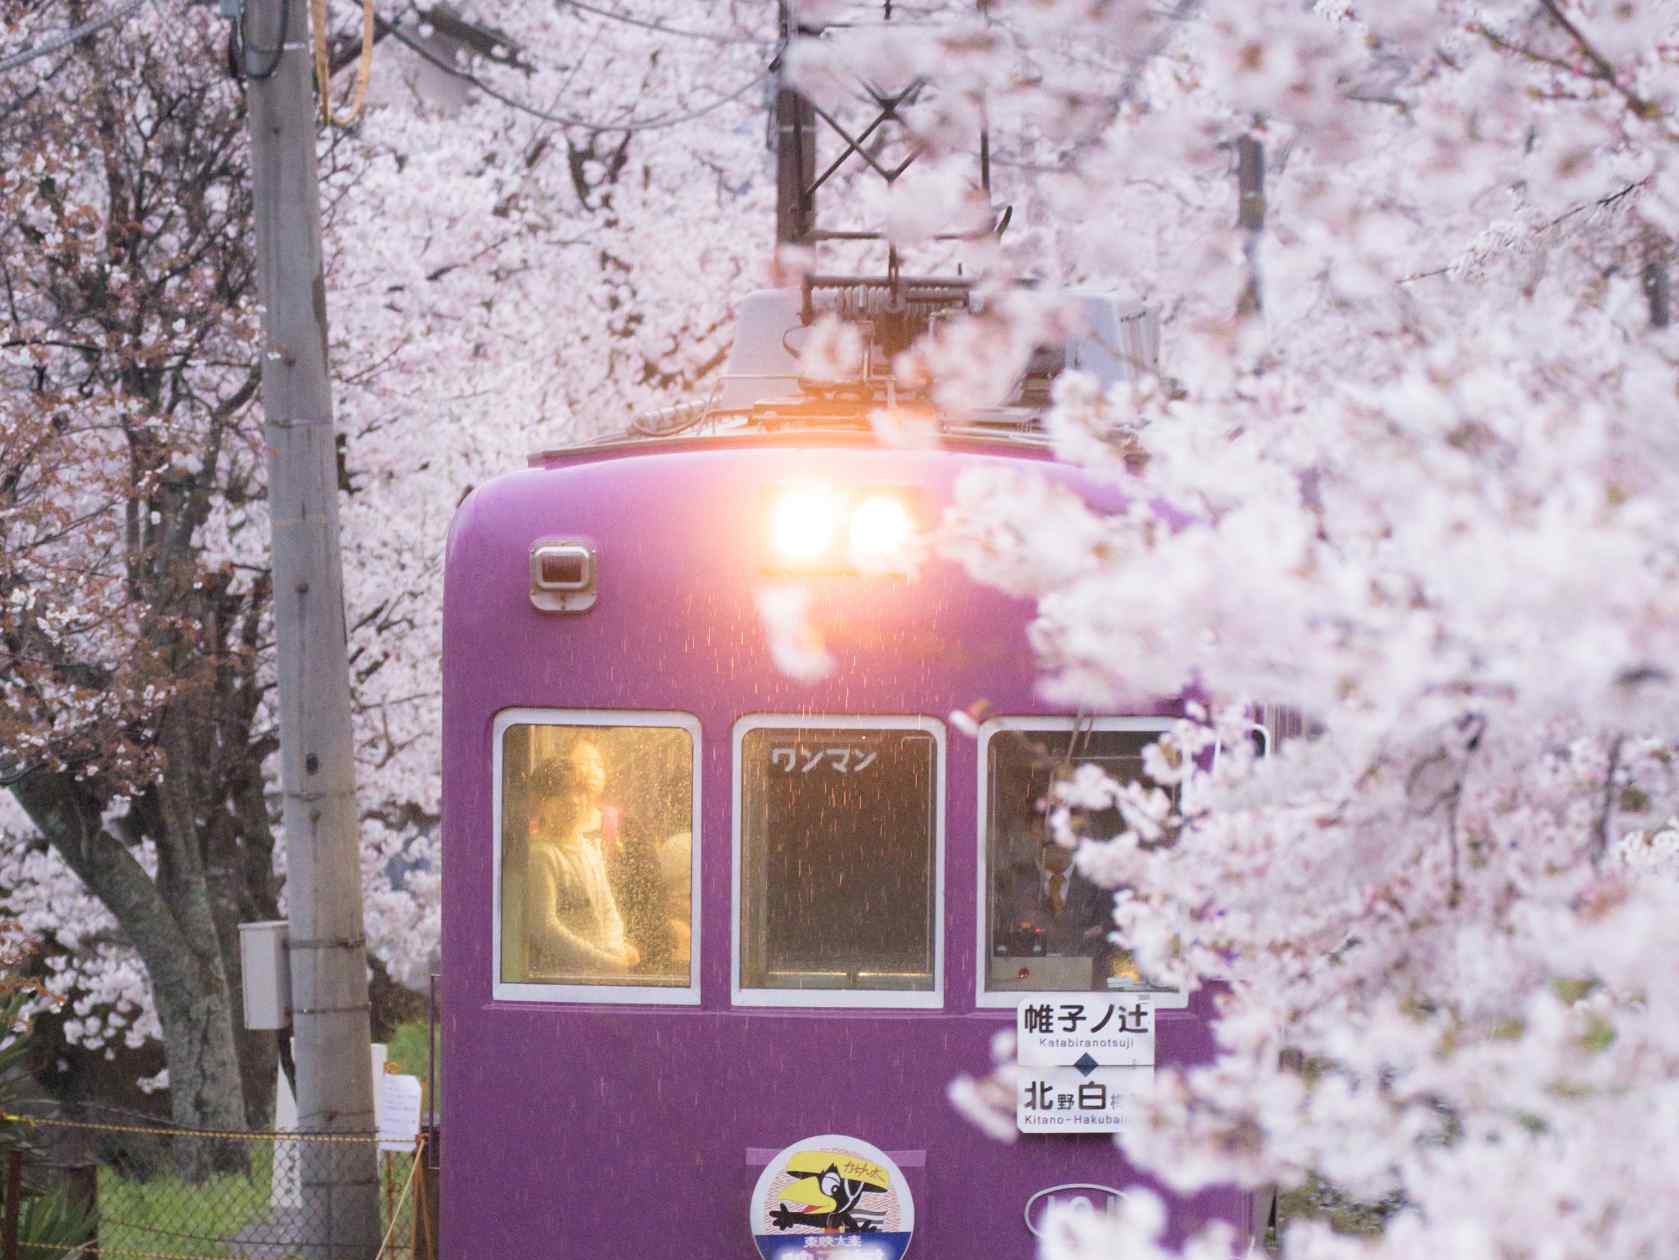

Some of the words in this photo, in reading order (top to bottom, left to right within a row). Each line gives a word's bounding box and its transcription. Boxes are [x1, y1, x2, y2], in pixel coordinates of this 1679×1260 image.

[771, 747, 878, 773] ワンマン
[1023, 1003, 1149, 1034] 帷子ノ辻
[1039, 1037, 1134, 1049] Katabiranotsuji
[1024, 1080, 1123, 1111] 北野白
